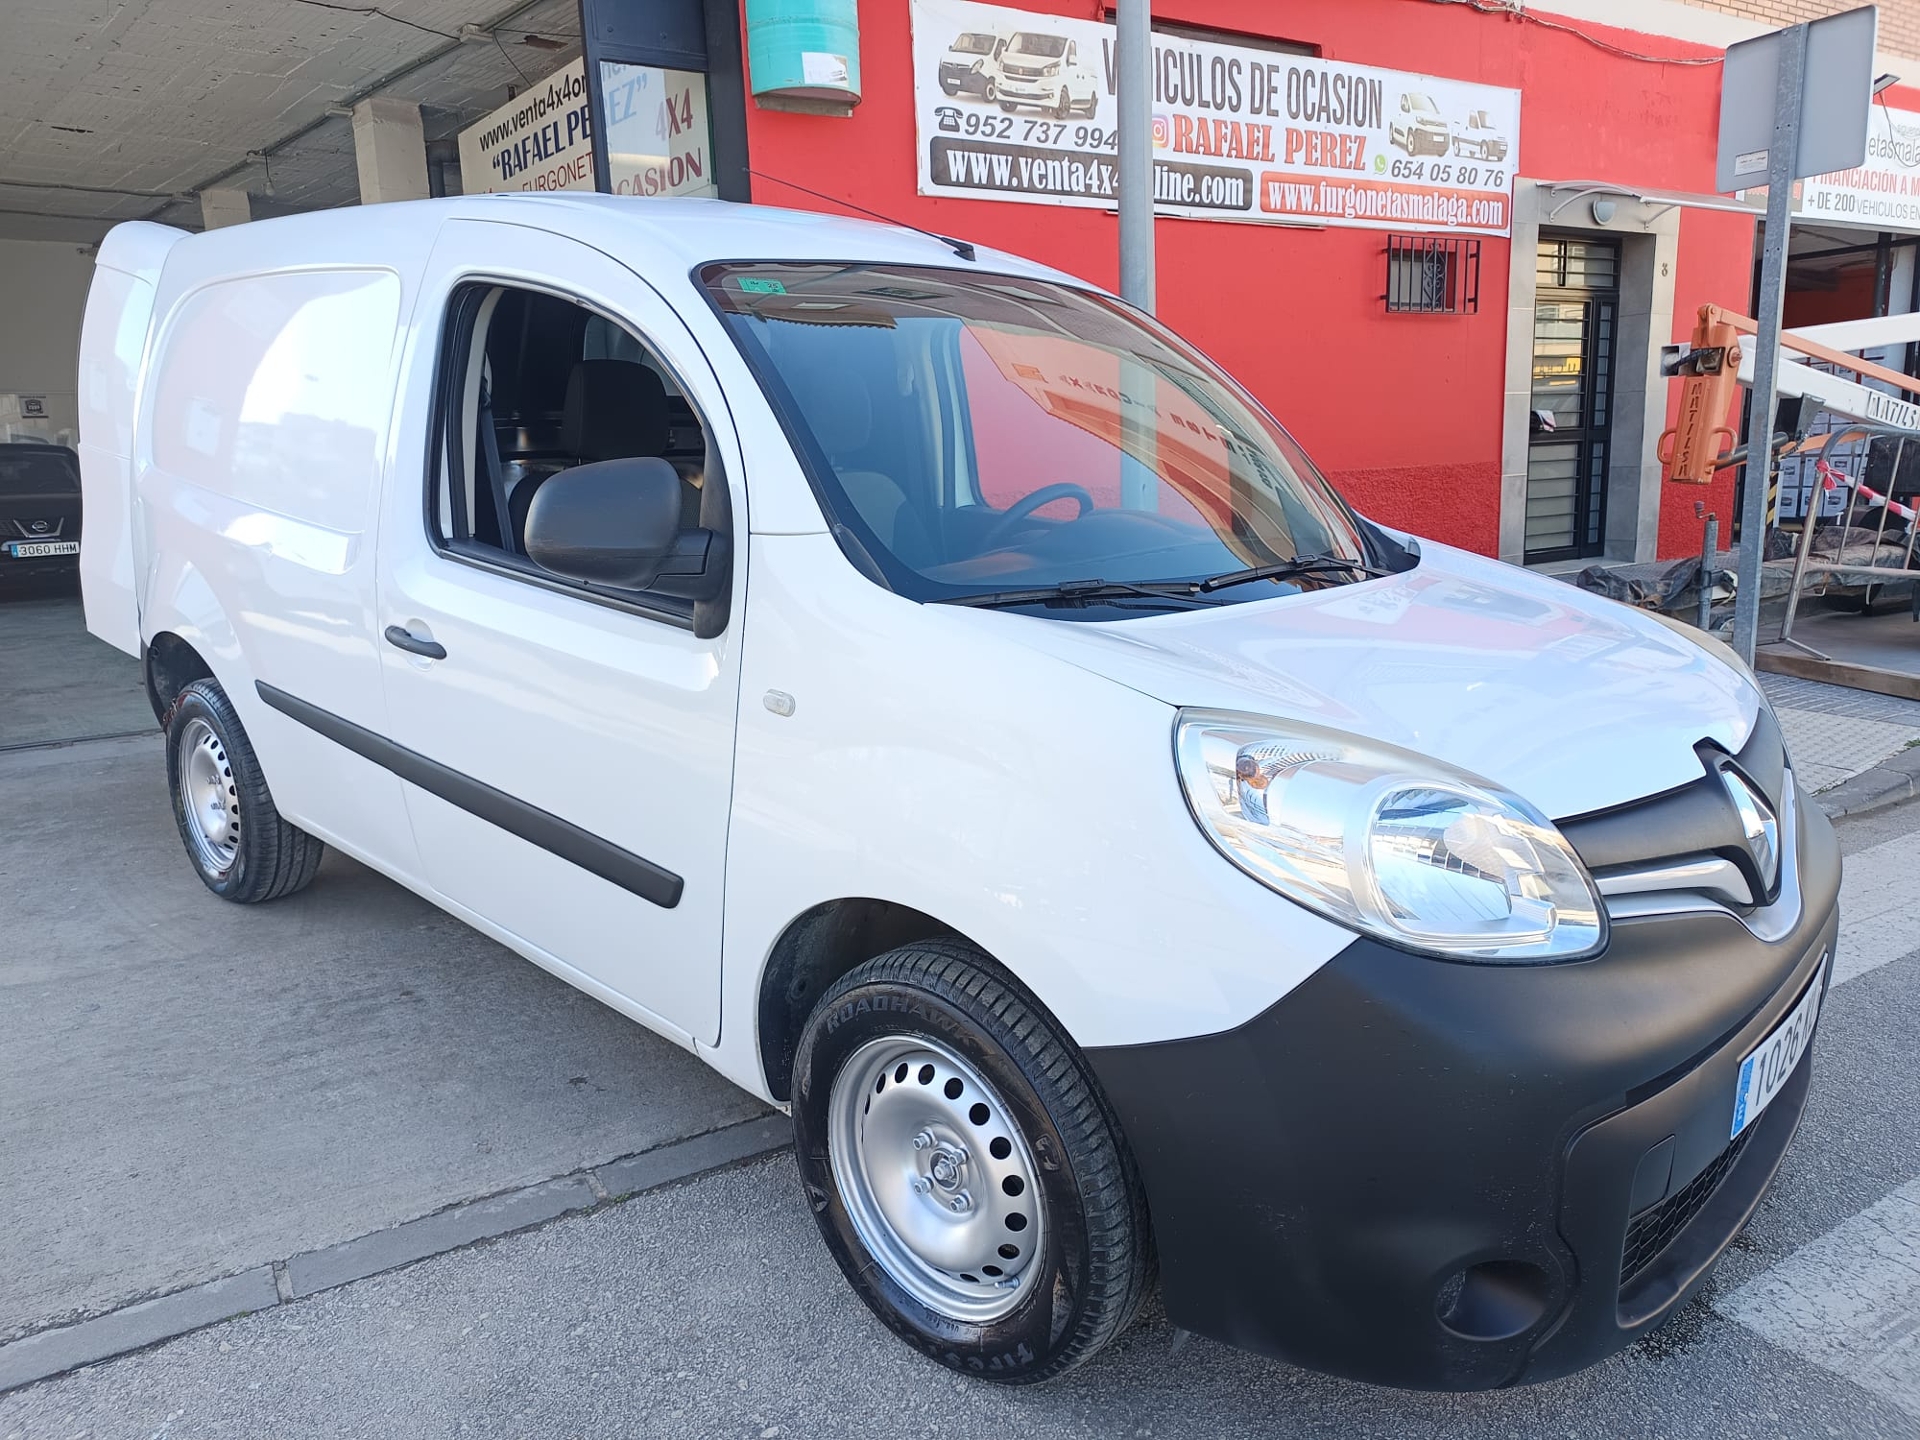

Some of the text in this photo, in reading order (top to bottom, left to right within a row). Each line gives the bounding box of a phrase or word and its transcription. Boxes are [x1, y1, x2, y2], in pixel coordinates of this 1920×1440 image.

[1102, 38, 1383, 129] VICULOS DE OCASION
[655, 87, 693, 141] 4X4
[964, 112, 1118, 151] 952 737 994
[1173, 113, 1367, 171] RAFAEL PEREZ
[611, 147, 702, 196] CASION
[1391, 159, 1504, 188] 654 05 80 76
[1900, 174, 1908, 195] A
[1268, 181, 1503, 226] www.furgonetasmalaga.com
[1817, 191, 1832, 210] DE
[1834, 193, 1855, 213] 200
[1857, 199, 1908, 220] VEHICULOS
[1679, 382, 1703, 477] MATILSA
[20, 543, 77, 556] 3060 HHM
[1756, 1012, 1804, 1107] 1026
